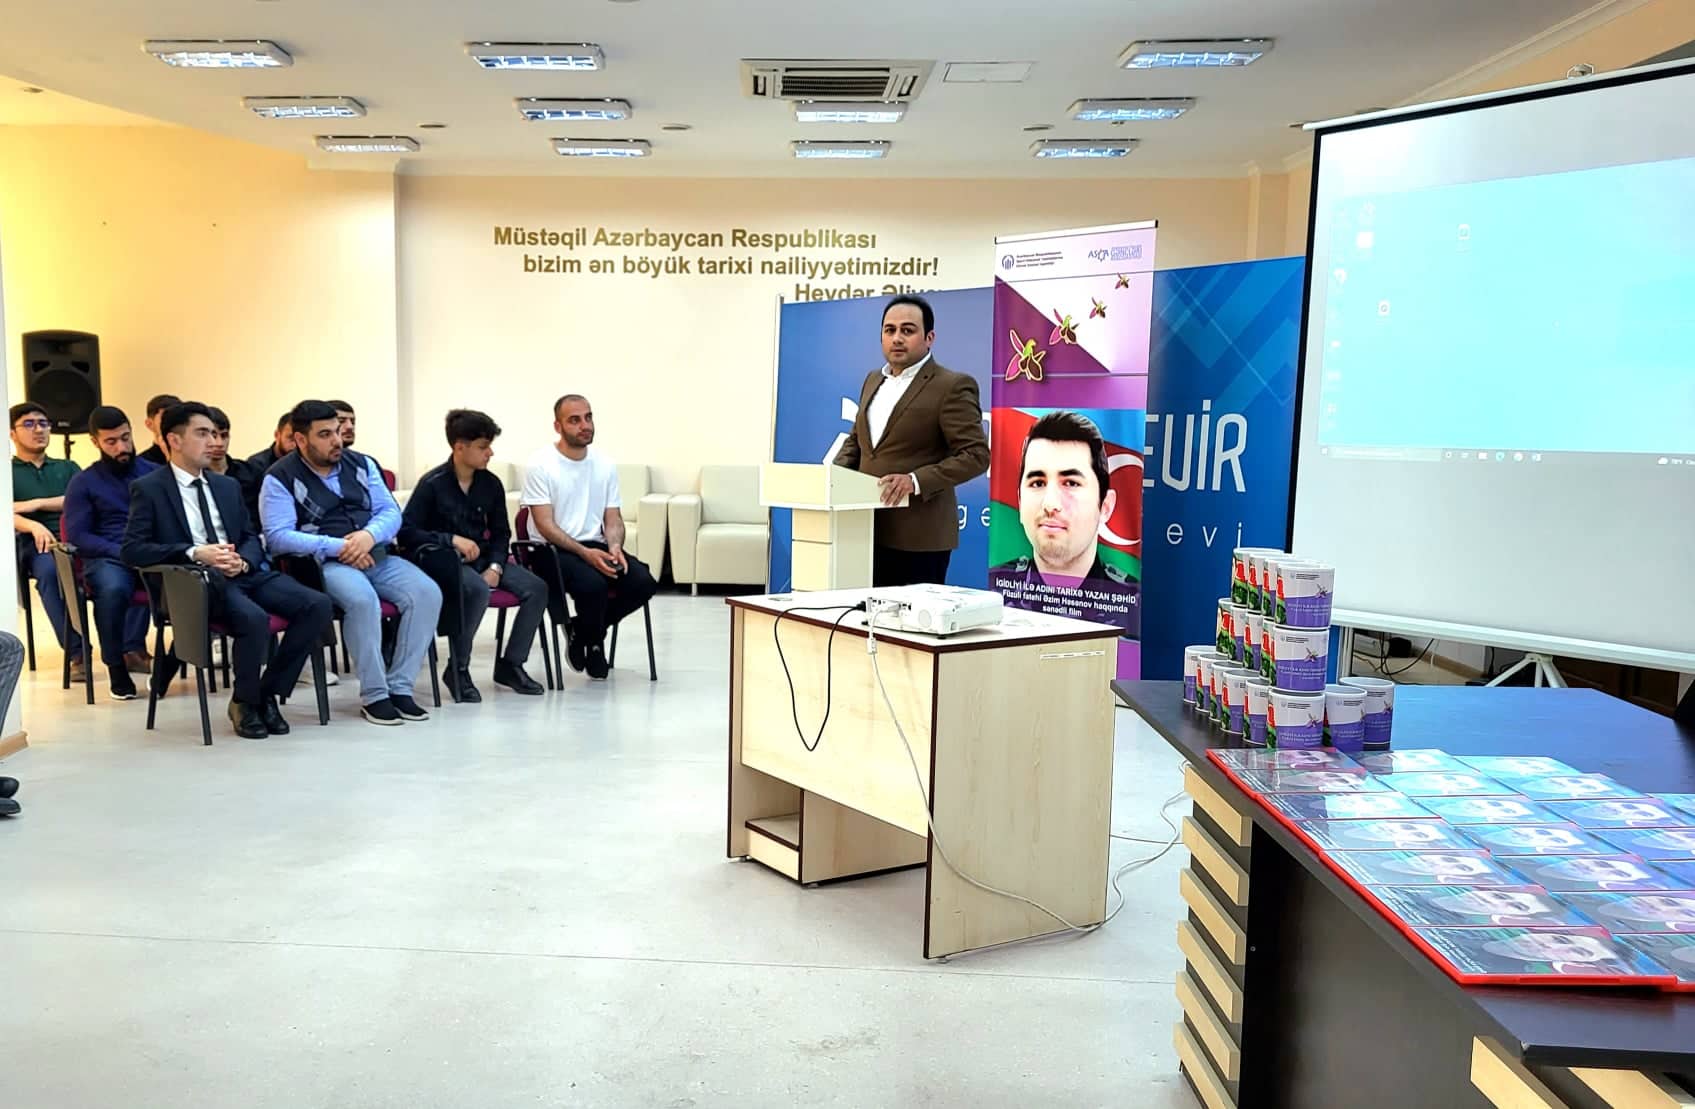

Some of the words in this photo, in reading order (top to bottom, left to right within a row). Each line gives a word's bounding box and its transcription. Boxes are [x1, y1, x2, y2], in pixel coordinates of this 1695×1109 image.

[493, 226, 588, 251] Müstəqil
[593, 227, 724, 251] Azərbaycan
[731, 228, 877, 252] Respublikası
[523, 253, 582, 274] bizim
[588, 259, 615, 275] ən
[623, 254, 691, 279] böyük
[698, 255, 753, 276] tarixi
[760, 255, 939, 280] nailiyyətimizdir!
[1084, 590, 1110, 602] YAZAN
[1068, 607, 1082, 617] film
